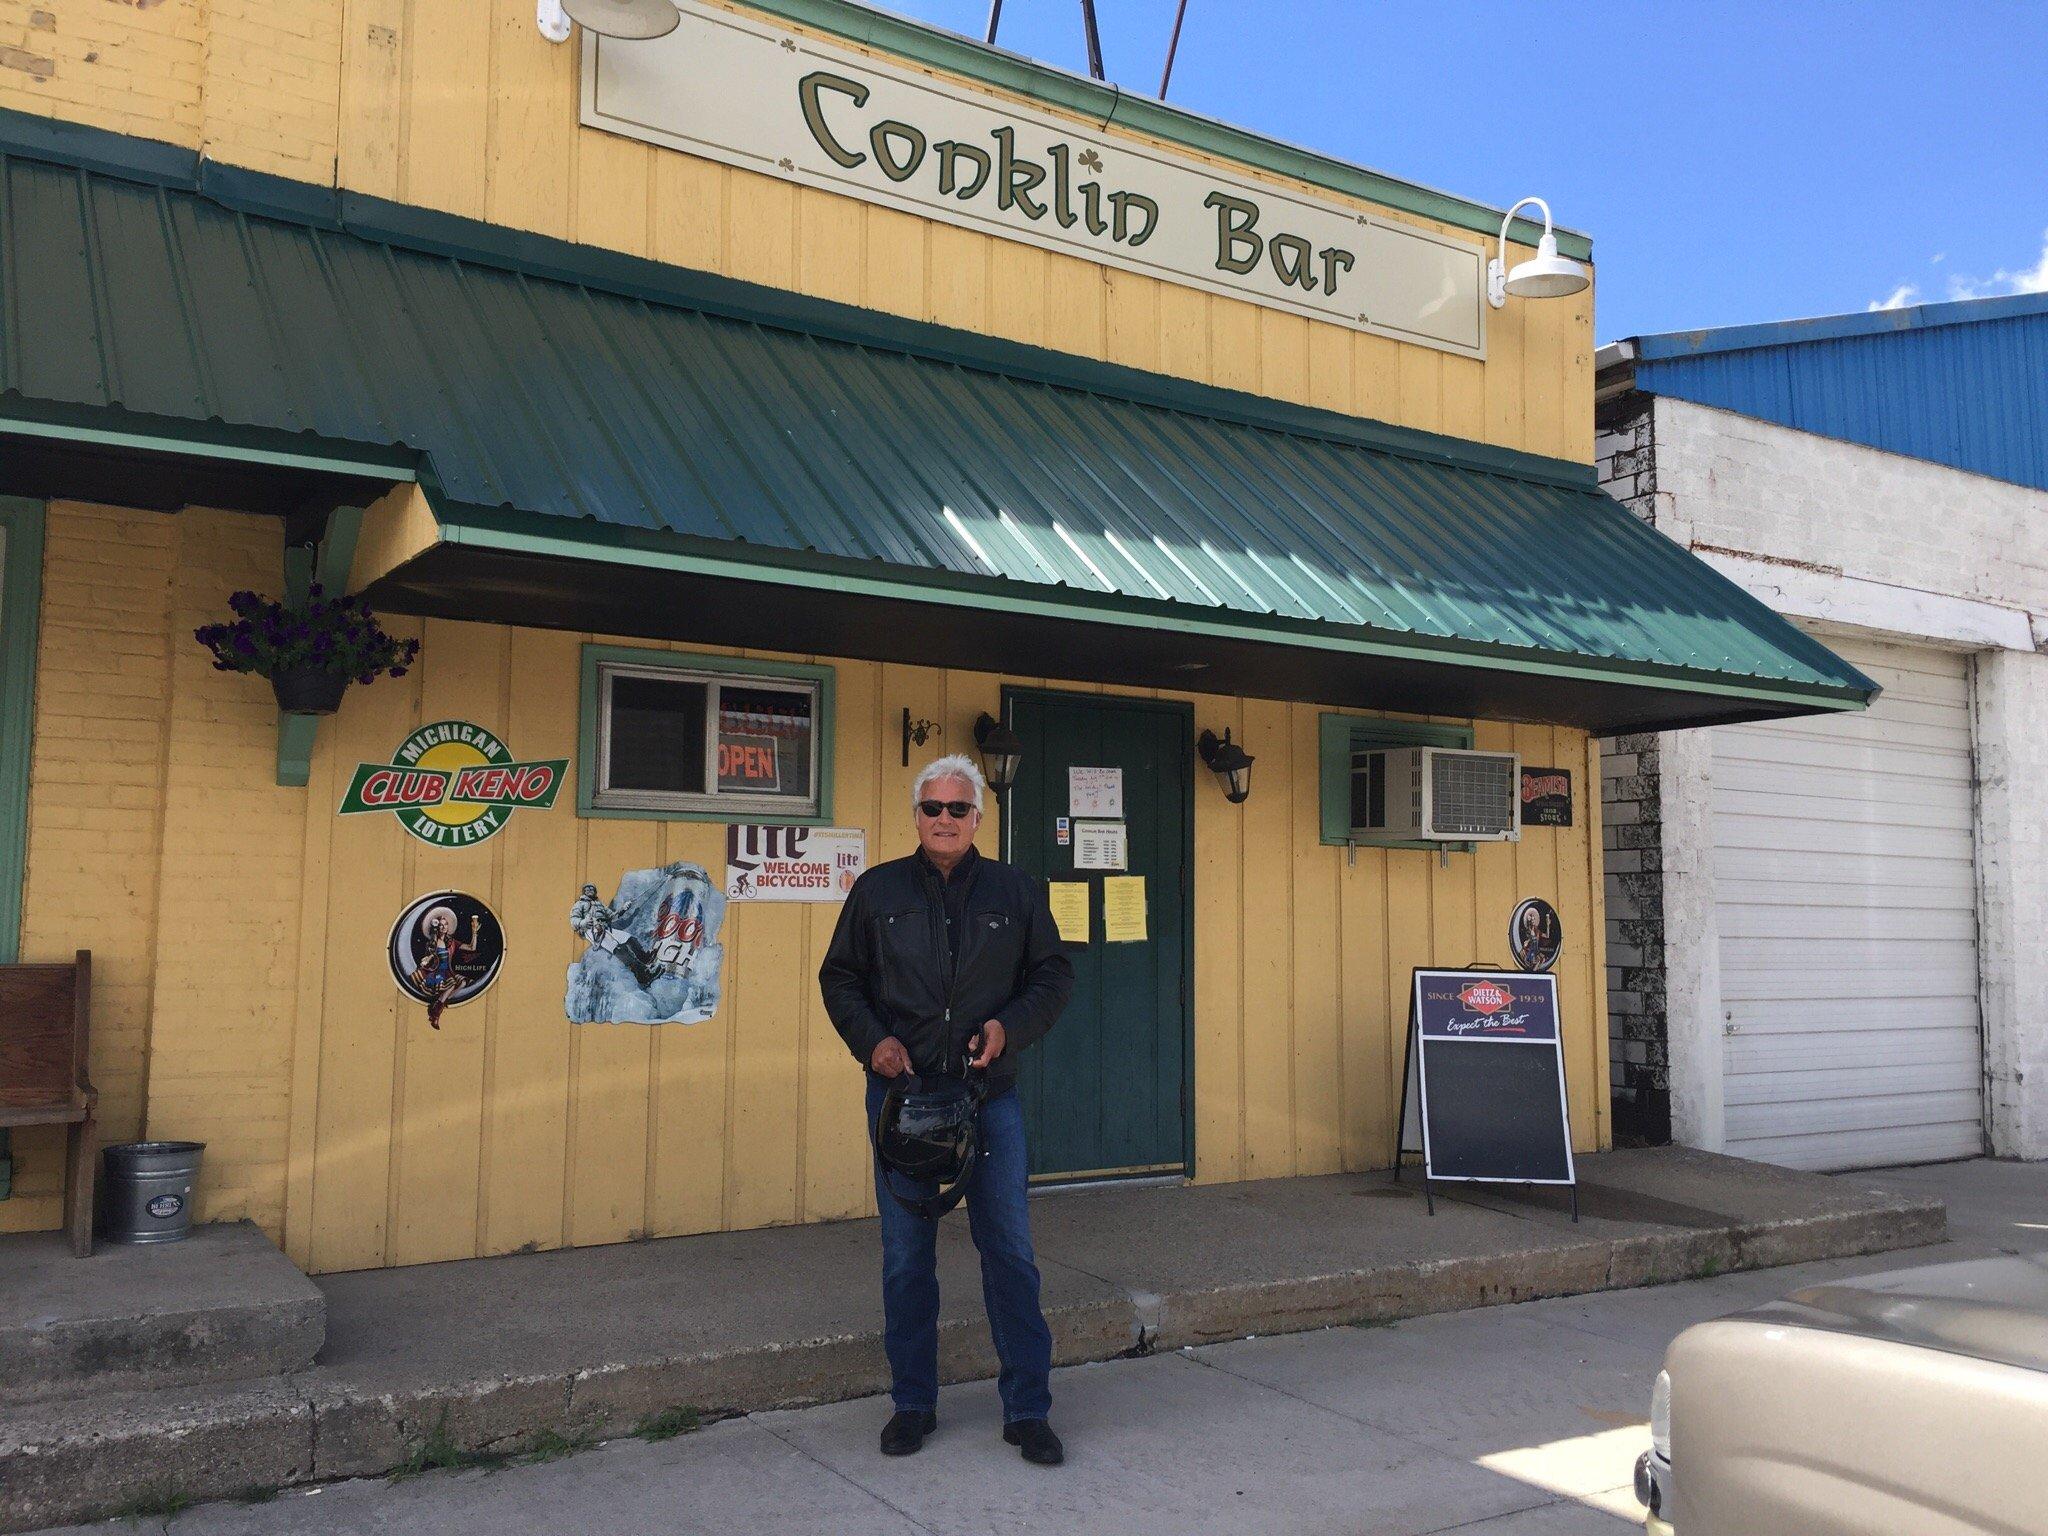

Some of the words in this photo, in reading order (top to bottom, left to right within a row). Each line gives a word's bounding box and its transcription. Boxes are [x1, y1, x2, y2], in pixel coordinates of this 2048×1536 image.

[799, 71, 1158, 247] Conklin
[1204, 191, 1355, 295] Bar
[401, 724, 501, 763] MICHIGAN
[718, 743, 773, 778] OPEN
[361, 770, 446, 805] CLUB
[453, 766, 553, 800] KENO
[1520, 774, 1568, 803] BEAMISH
[413, 811, 499, 844] LOTTERY
[756, 875, 830, 888] BICYCLISTS
[763, 862, 830, 875] WELCOME
[1427, 992, 1455, 1001] SINCE
[1520, 995, 1545, 1003] 1939
[1468, 996, 1503, 1005] WATSON
[1446, 1017, 1485, 1035] Expect
[1483, 1015, 1500, 1028] the
[1500, 1013, 1530, 1026] Best
